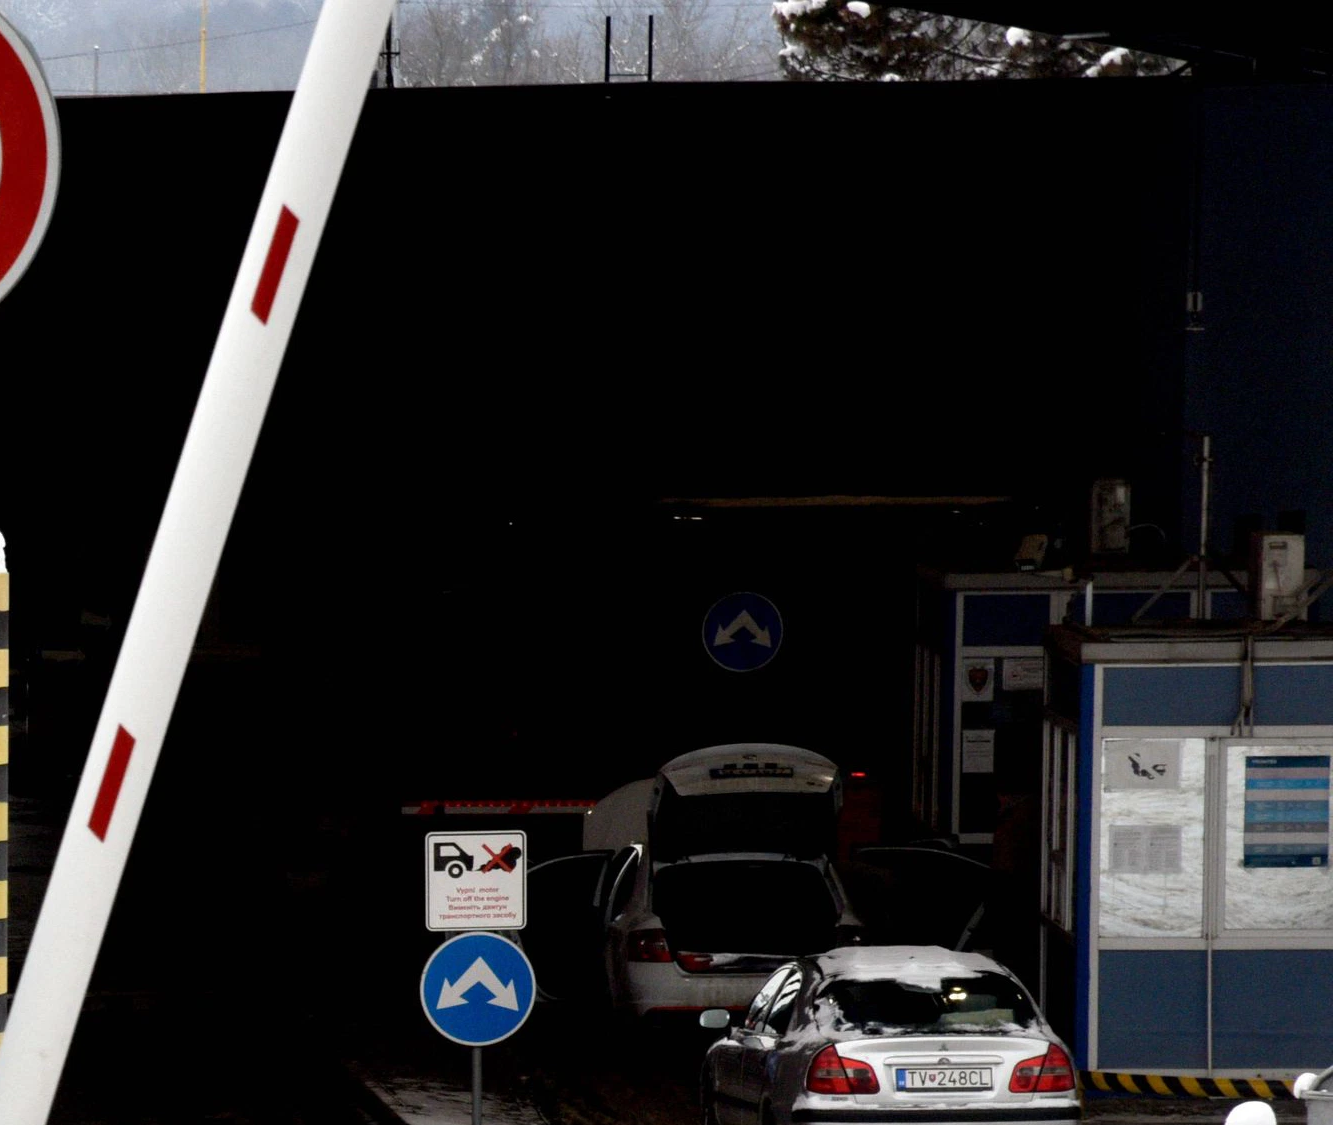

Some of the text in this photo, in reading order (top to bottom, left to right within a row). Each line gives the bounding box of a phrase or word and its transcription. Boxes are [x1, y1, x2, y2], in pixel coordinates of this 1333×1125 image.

[486, 895, 510, 903] engine
[908, 1071, 989, 1086] TV 248CL
